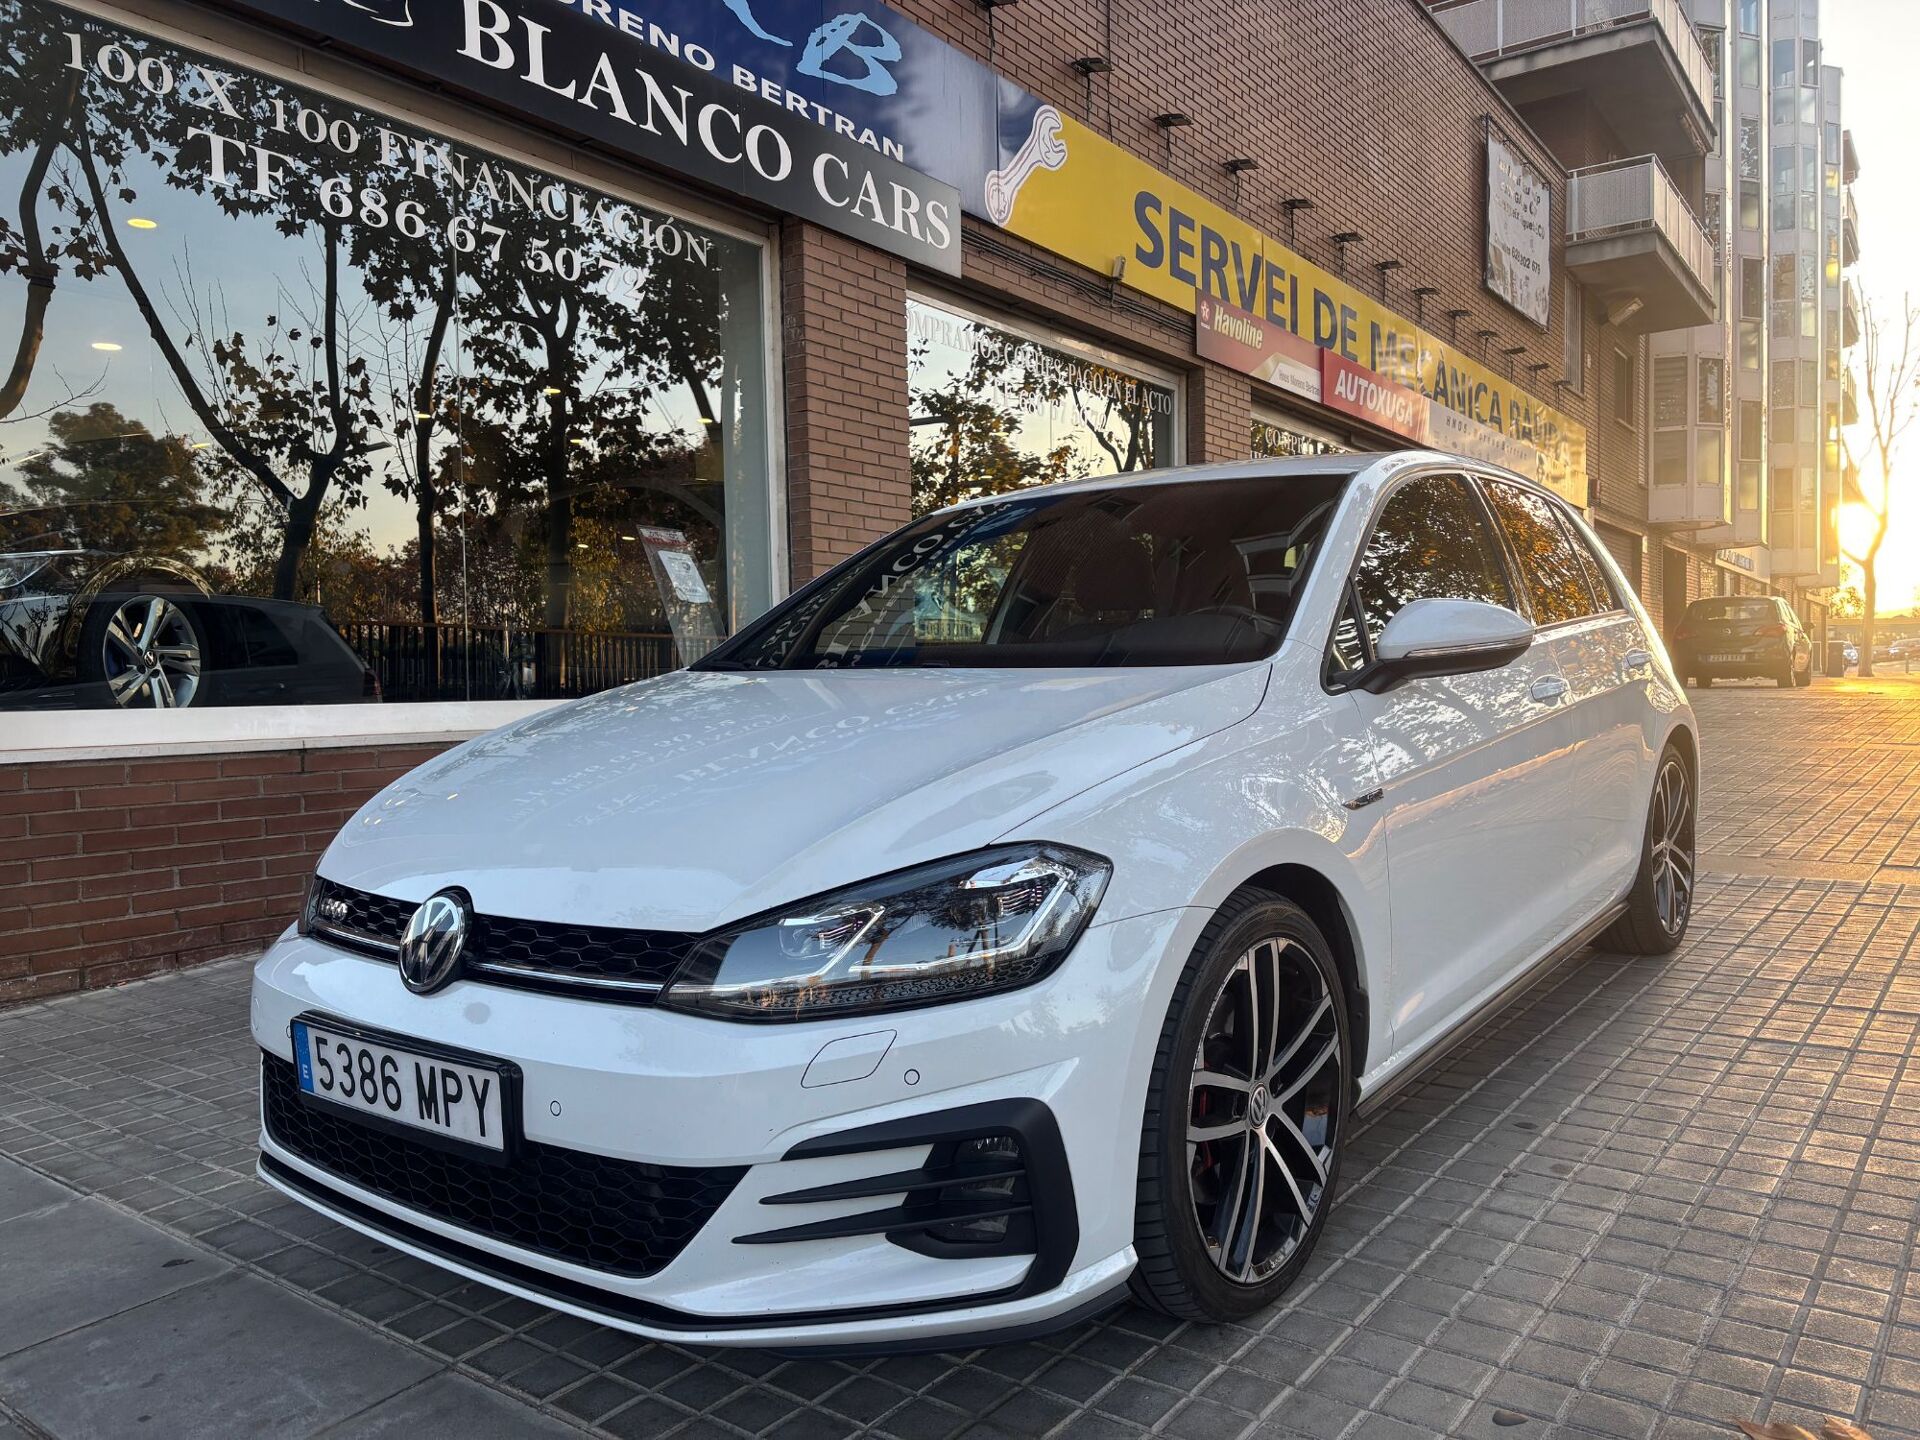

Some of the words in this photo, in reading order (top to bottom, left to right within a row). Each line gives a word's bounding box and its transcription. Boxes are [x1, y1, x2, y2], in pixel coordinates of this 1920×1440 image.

[63, 32, 174, 95] 100
[193, 64, 244, 120] X
[269, 99, 359, 154] 100
[374, 126, 710, 267] FINANCIACIÓN
[456, 0, 793, 182] BLANCO
[812, 152, 951, 250] CARS
[558, 0, 715, 71] RENO
[732, 63, 905, 163] BERTRAN
[187, 126, 296, 200] TF
[320, 177, 426, 238] 686
[447, 216, 507, 262] 67
[526, 238, 581, 282] 50
[1134, 190, 1298, 336] SERVEI
[1313, 288, 1358, 363] DE
[1068, 363, 1103, 393] PAGO
[1106, 375, 1122, 401] EN
[1125, 383, 1140, 405] EL
[1141, 387, 1172, 416] ACTO
[1213, 304, 1264, 351] Havoline
[1334, 369, 1413, 427] AUTOXUGA
[315, 1035, 402, 1112] 5386
[415, 1062, 490, 1137] MPY
